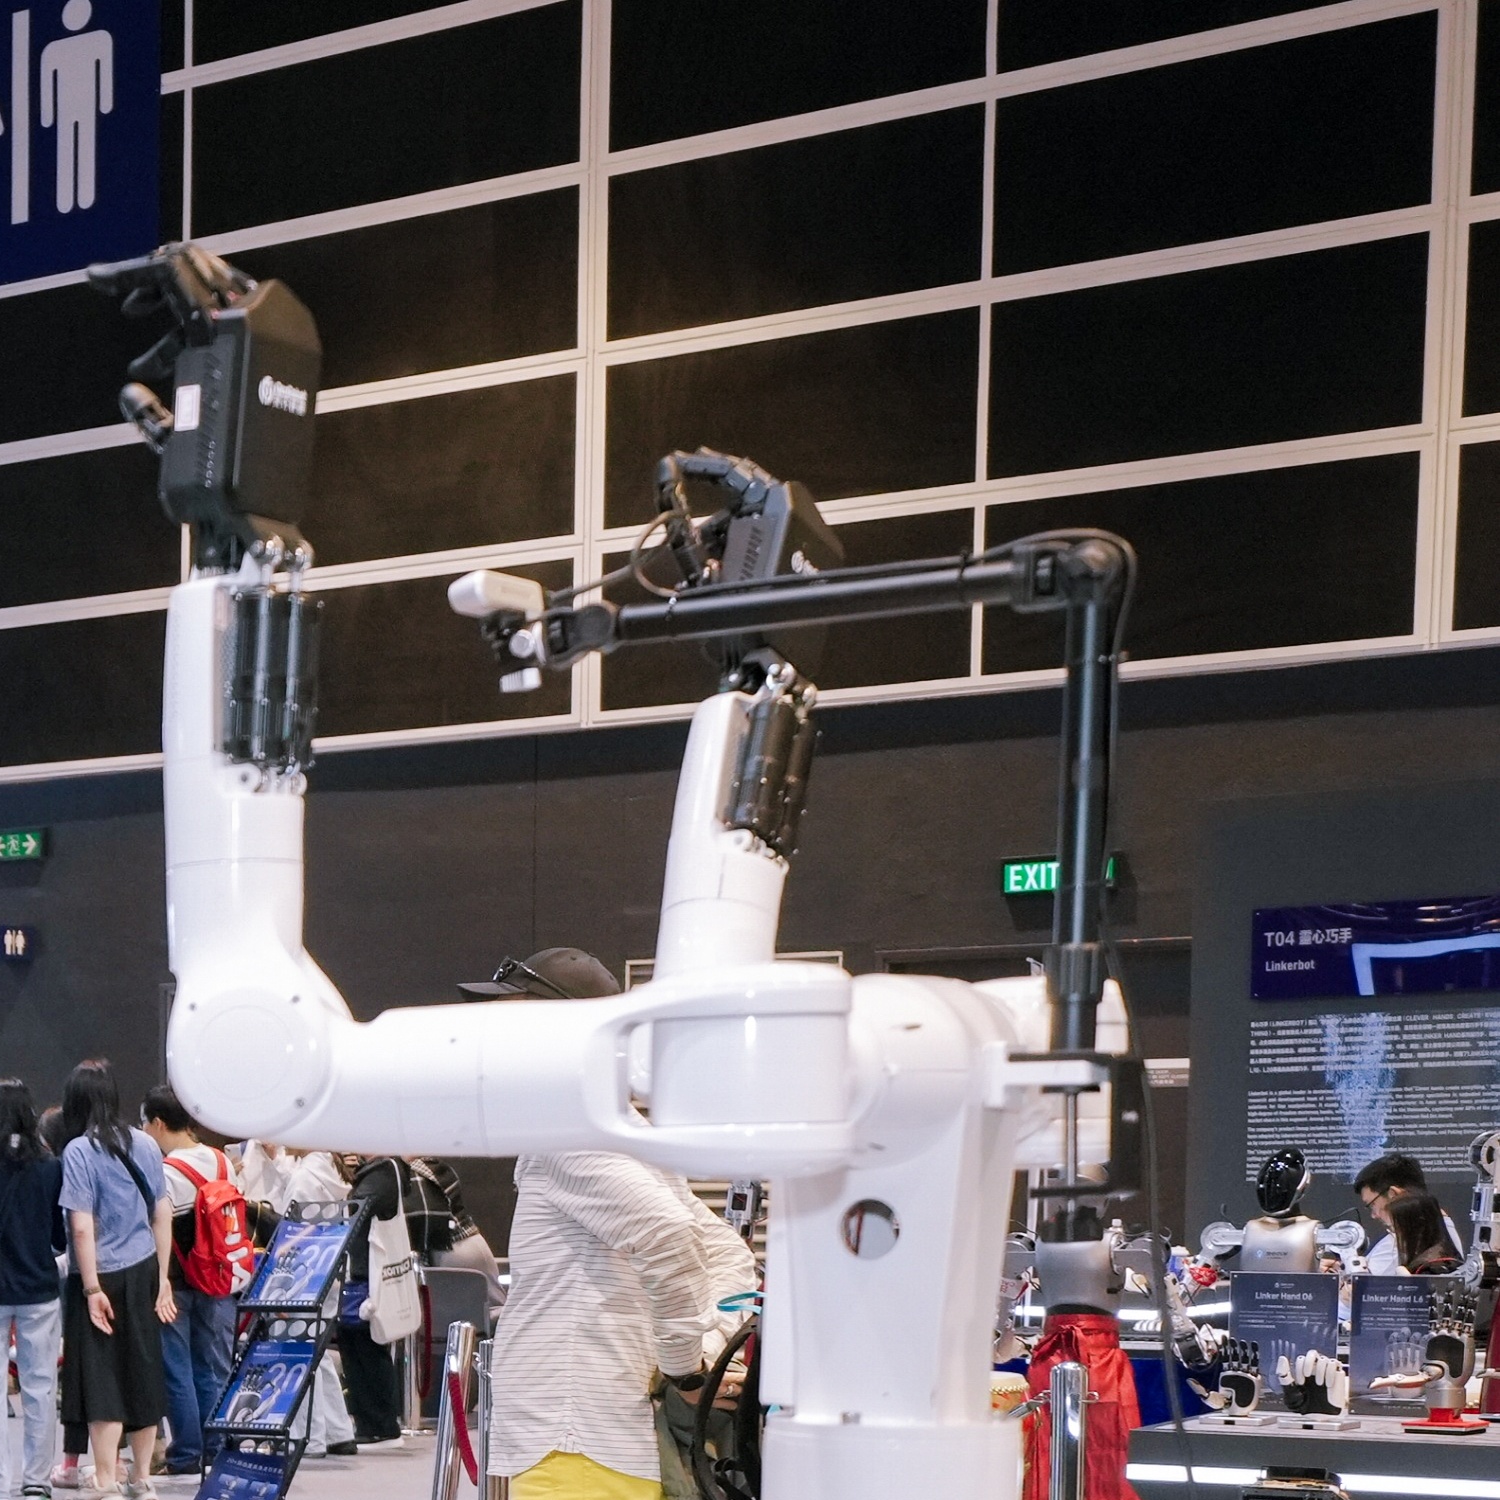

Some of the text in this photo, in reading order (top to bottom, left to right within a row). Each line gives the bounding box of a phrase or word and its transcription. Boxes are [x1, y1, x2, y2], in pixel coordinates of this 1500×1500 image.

[1009, 862, 1060, 891] EXIT
[1264, 931, 1295, 947] T04
[1265, 960, 1315, 972] Linkerbot
[1255, 1292, 1279, 1301] Linker
[1280, 1292, 1302, 1301] Hand
[1362, 1294, 1389, 1303] Linker
[1390, 1294, 1412, 1304] Hand
